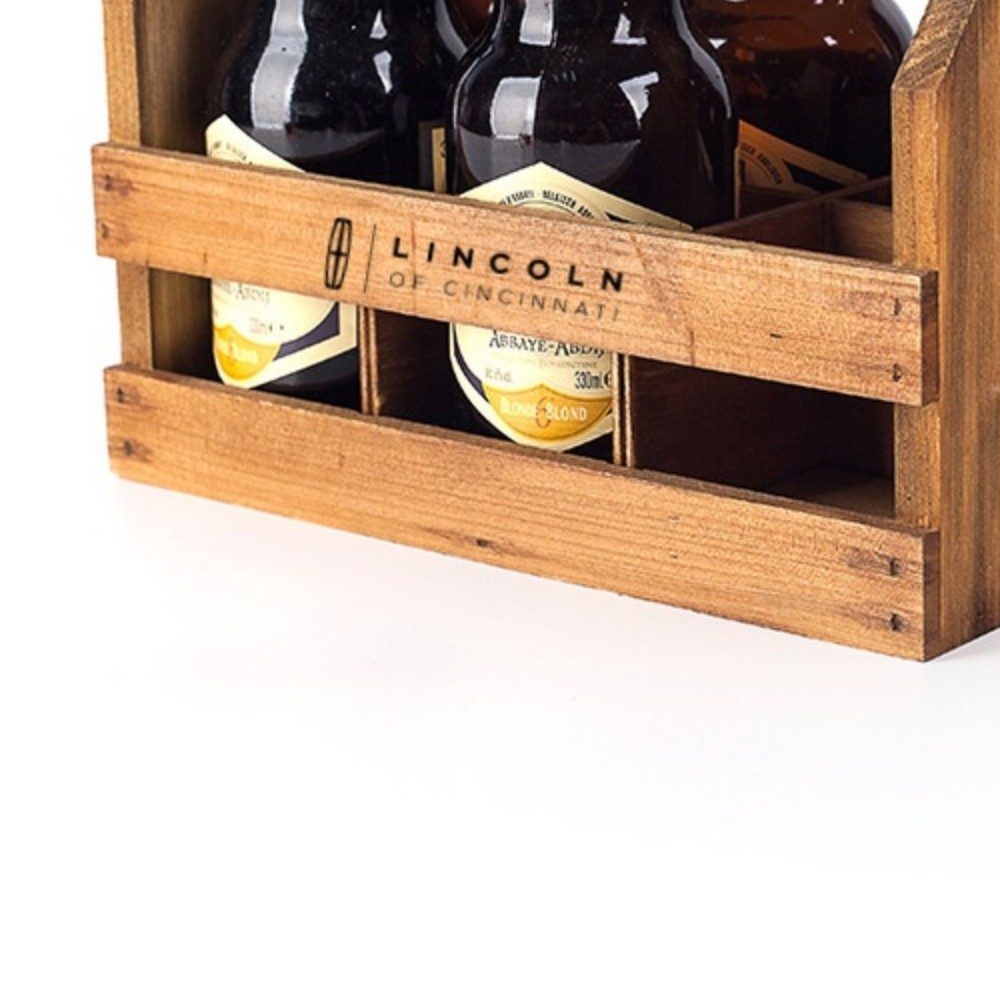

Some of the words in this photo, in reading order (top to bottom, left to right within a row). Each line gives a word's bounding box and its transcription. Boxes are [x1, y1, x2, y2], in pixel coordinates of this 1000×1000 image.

[392, 237, 624, 292] LINCOLN
[388, 271, 426, 290] OF
[443, 279, 620, 322] CINCINNATI
